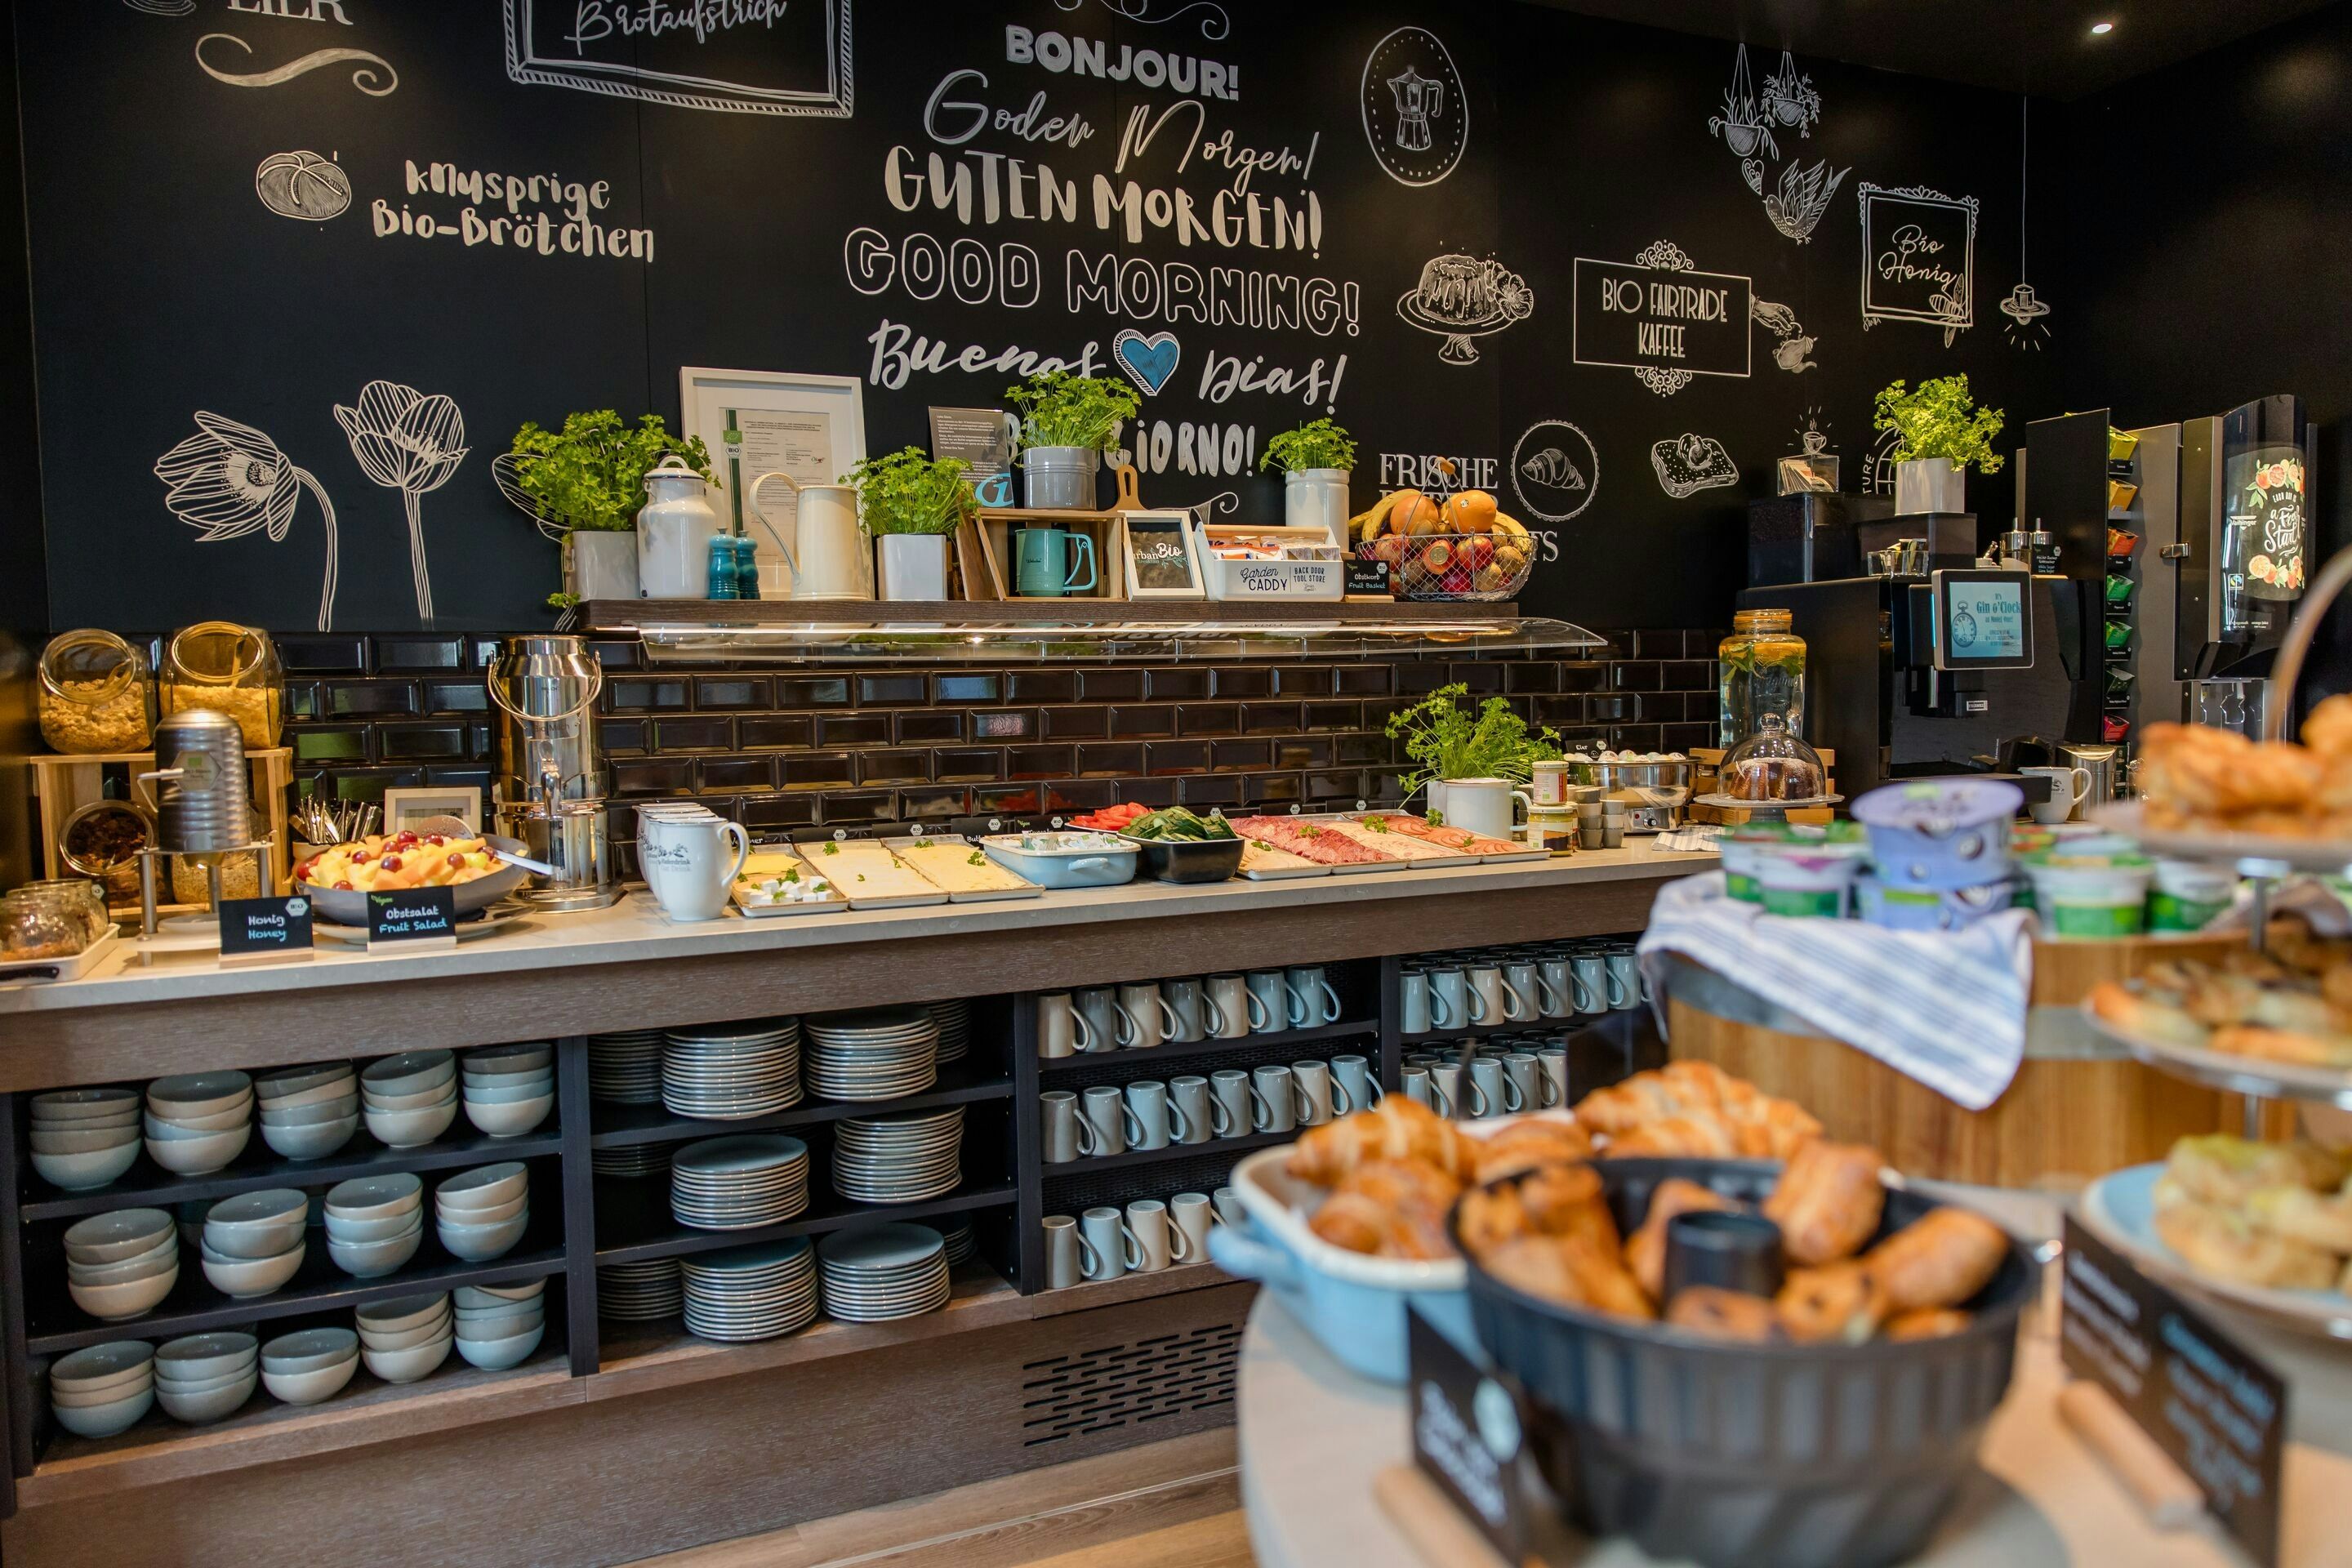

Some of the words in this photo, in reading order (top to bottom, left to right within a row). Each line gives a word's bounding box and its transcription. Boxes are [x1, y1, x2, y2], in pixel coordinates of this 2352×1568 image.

[1005, 24, 1241, 101] BONJOUR!
[923, 69, 1095, 149] Goden
[1115, 100, 1320, 196] Morgen!
[884, 145, 1076, 225] GUTEN
[1093, 173, 1322, 260] MORGEN!
[372, 198, 653, 263] Bio-Brötchen
[1892, 224, 1944, 254] Bio
[844, 227, 1040, 307] GOOD
[1067, 248, 1360, 336] MORNING!
[1878, 250, 1958, 301] Honig
[1602, 277, 1643, 314] BIO
[1650, 283, 1729, 323] FAIRTRADE
[867, 318, 1107, 390] Buenos
[1638, 322, 1686, 359] KAFFEE
[1379, 453, 1499, 489] FRISCHE
[1156, 542, 1183, 559] Bio
[1240, 566, 1279, 583] Garden
[1294, 567, 1309, 575] BACK
[1248, 578, 1288, 591] CADDY
[1294, 575, 1307, 583] TOOL
[1308, 575, 1325, 583] STORE
[1976, 600, 1990, 614] Gin
[247, 914, 285, 928] Honig
[379, 921, 410, 933] Fruit
[413, 917, 448, 931] Salad
[385, 905, 439, 920] Obstsalat
[247, 929, 287, 942] Honey
